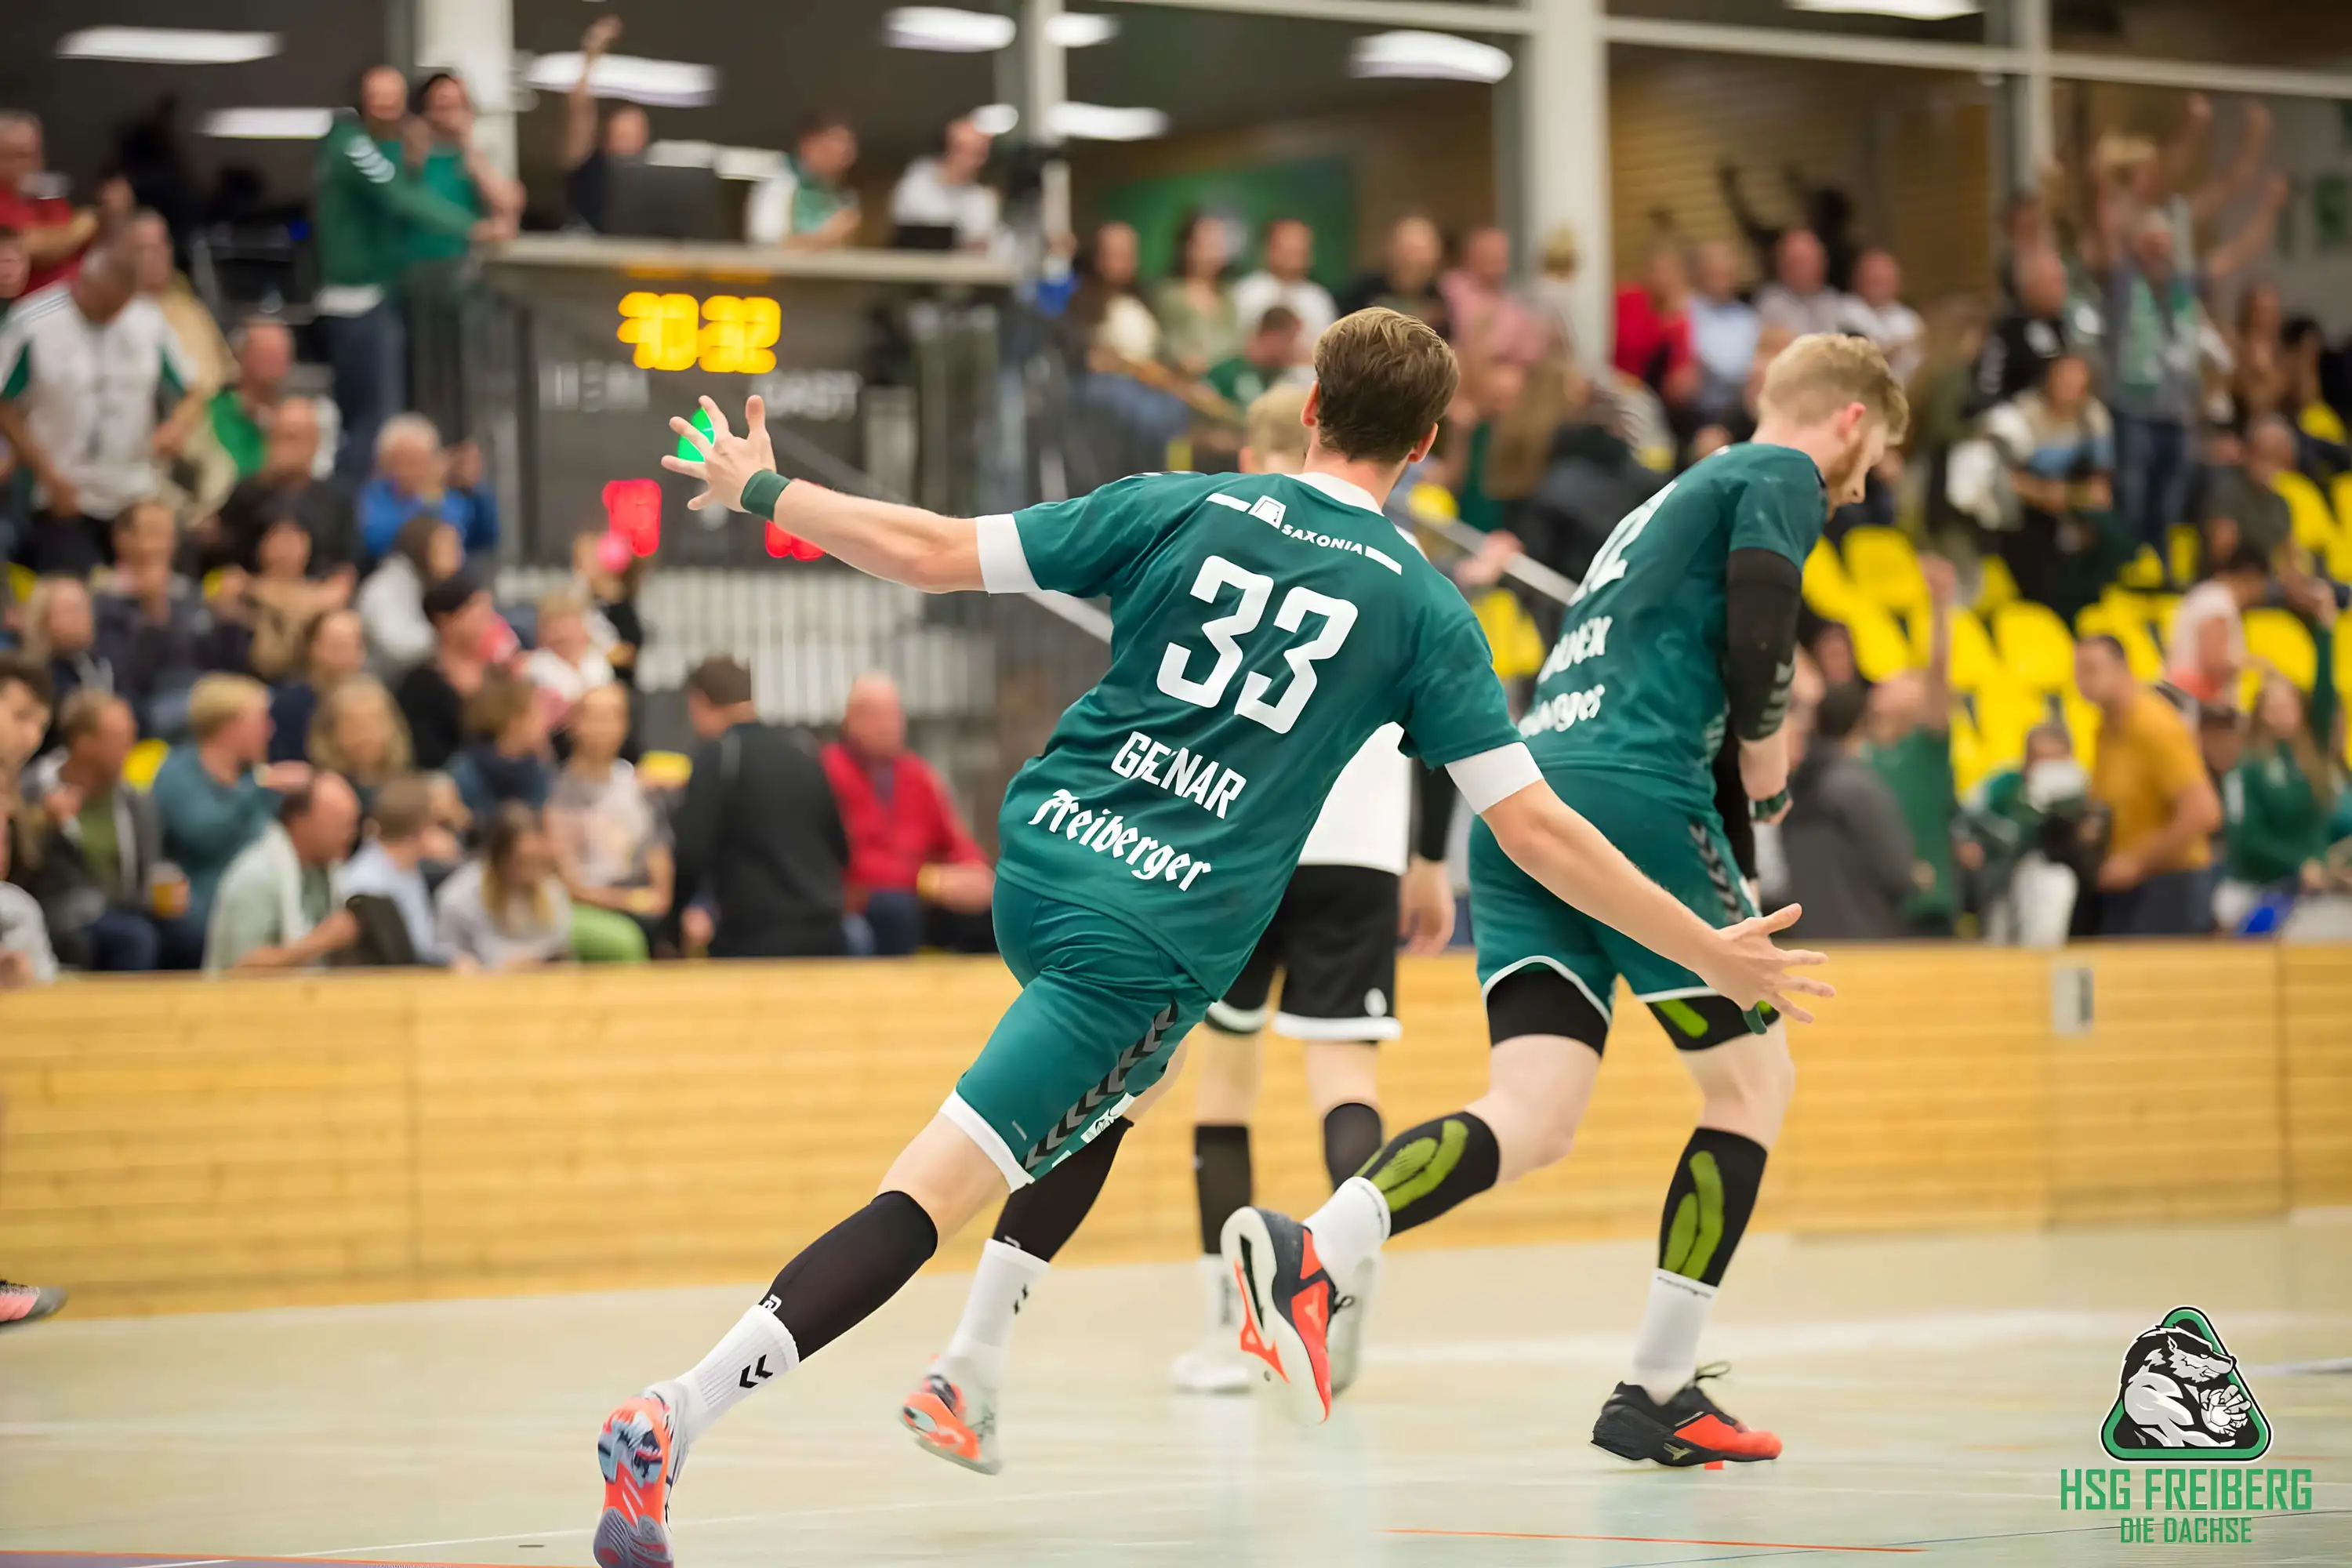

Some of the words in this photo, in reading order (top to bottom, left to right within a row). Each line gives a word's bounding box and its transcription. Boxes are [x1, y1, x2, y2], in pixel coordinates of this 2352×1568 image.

[1281, 524, 1363, 555] SAXONIA
[1156, 555, 1359, 735] 33
[1111, 731, 1247, 819] GENAR
[1028, 789, 1211, 892] Freiberger
